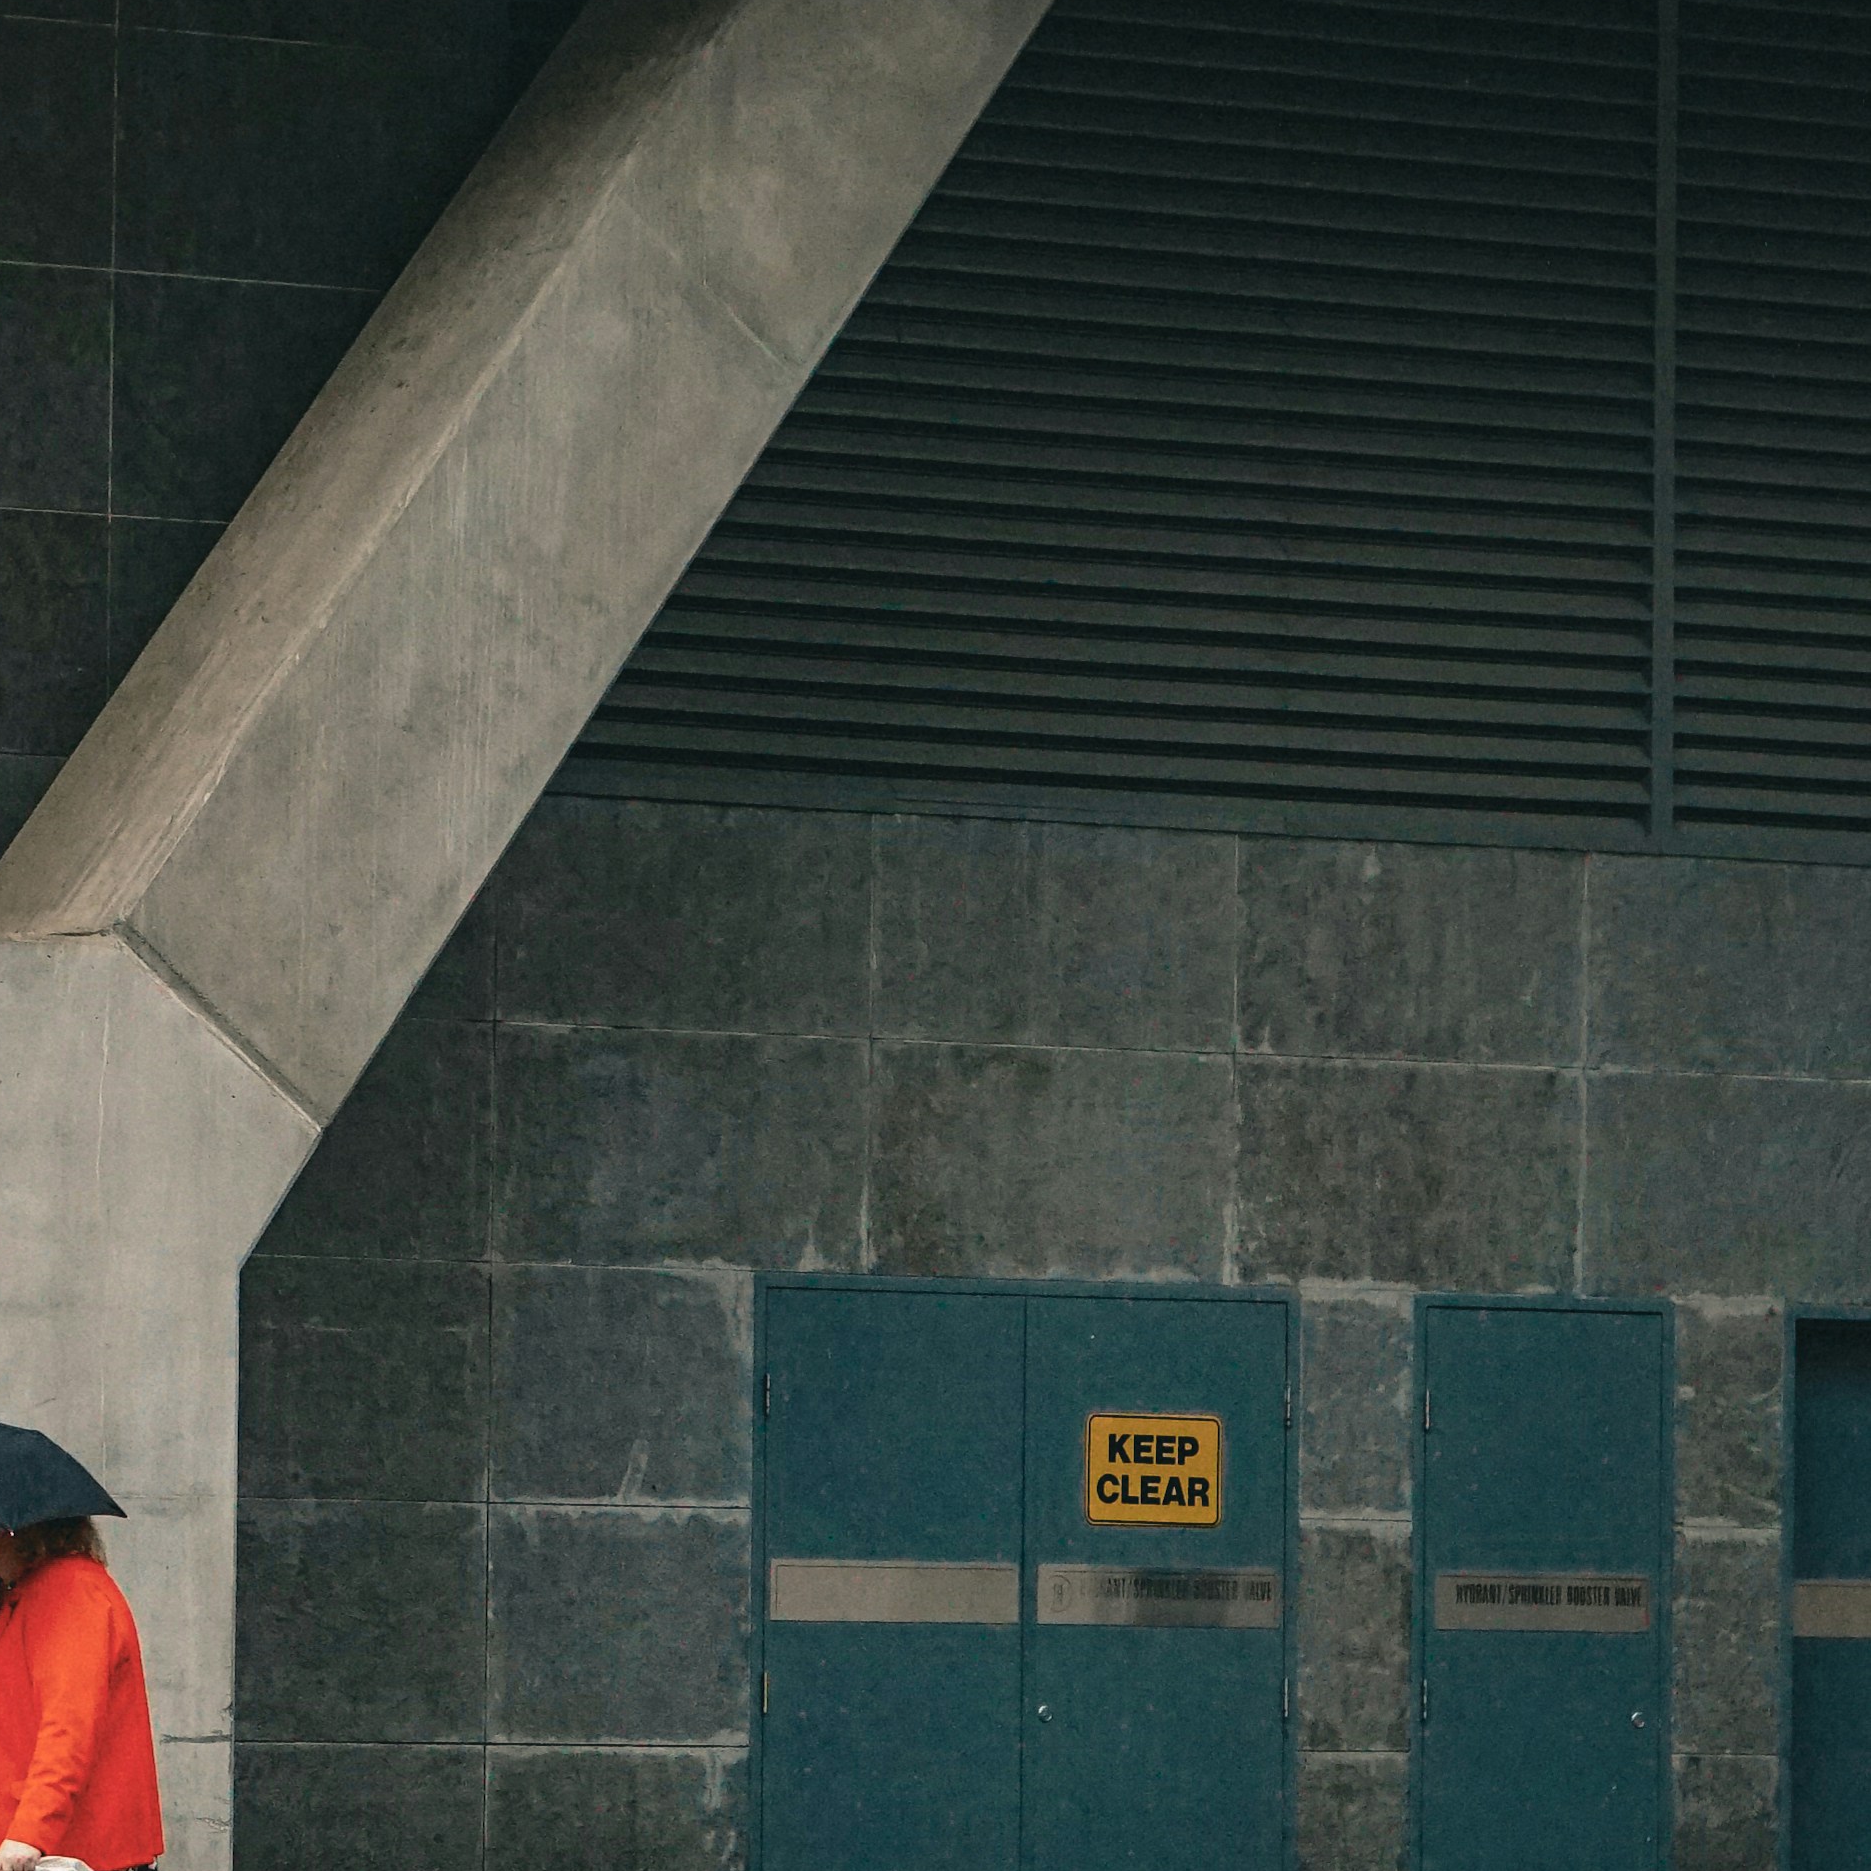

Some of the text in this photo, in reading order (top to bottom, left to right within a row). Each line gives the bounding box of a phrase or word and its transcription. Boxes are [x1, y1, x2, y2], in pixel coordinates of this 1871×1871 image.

[1108, 1433, 1199, 1465] KEEP
[1096, 1473, 1210, 1507] CLEAR
[1242, 1580, 1272, 1601] ALVE
[1567, 1585, 1610, 1606] BOOSTER
[1614, 1586, 1641, 1607] VALVE
